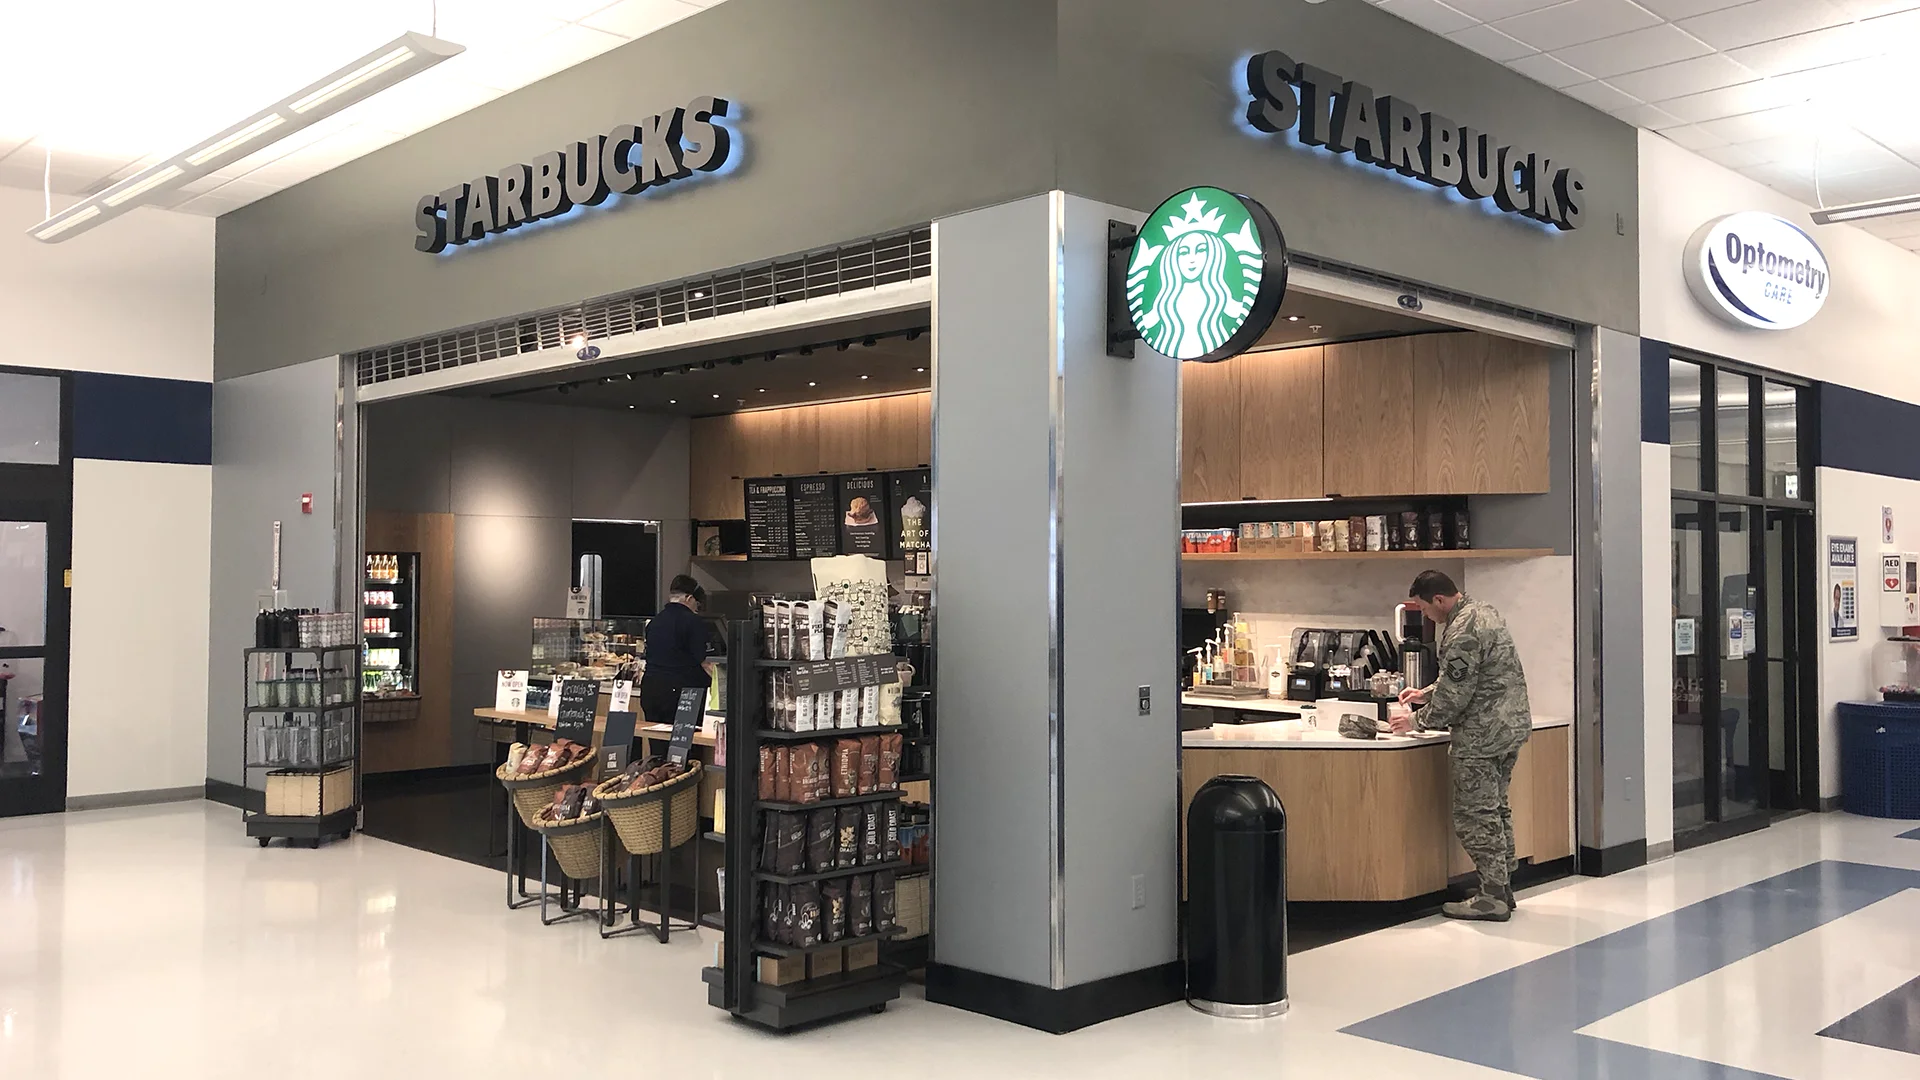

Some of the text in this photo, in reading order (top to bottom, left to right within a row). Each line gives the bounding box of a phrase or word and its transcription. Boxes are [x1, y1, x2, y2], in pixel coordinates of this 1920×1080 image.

[1246, 50, 1586, 230] STARBUCKS
[415, 96, 730, 254] STARBUCKS
[1725, 232, 1826, 299] Optometry
[1764, 281, 1793, 305] CARE
[800, 482, 826, 492] ESPRESSO
[846, 480, 874, 490] DELICIOUS
[900, 529, 929, 538] ART OF
[907, 518, 922, 526] THE
[899, 541, 931, 549] MATCHA
[1884, 559, 1899, 567] AED
[841, 748, 849, 775] ETHIOPIA
[867, 813, 876, 845] GOLD COAST
[888, 810, 897, 841] GOLD COAST
